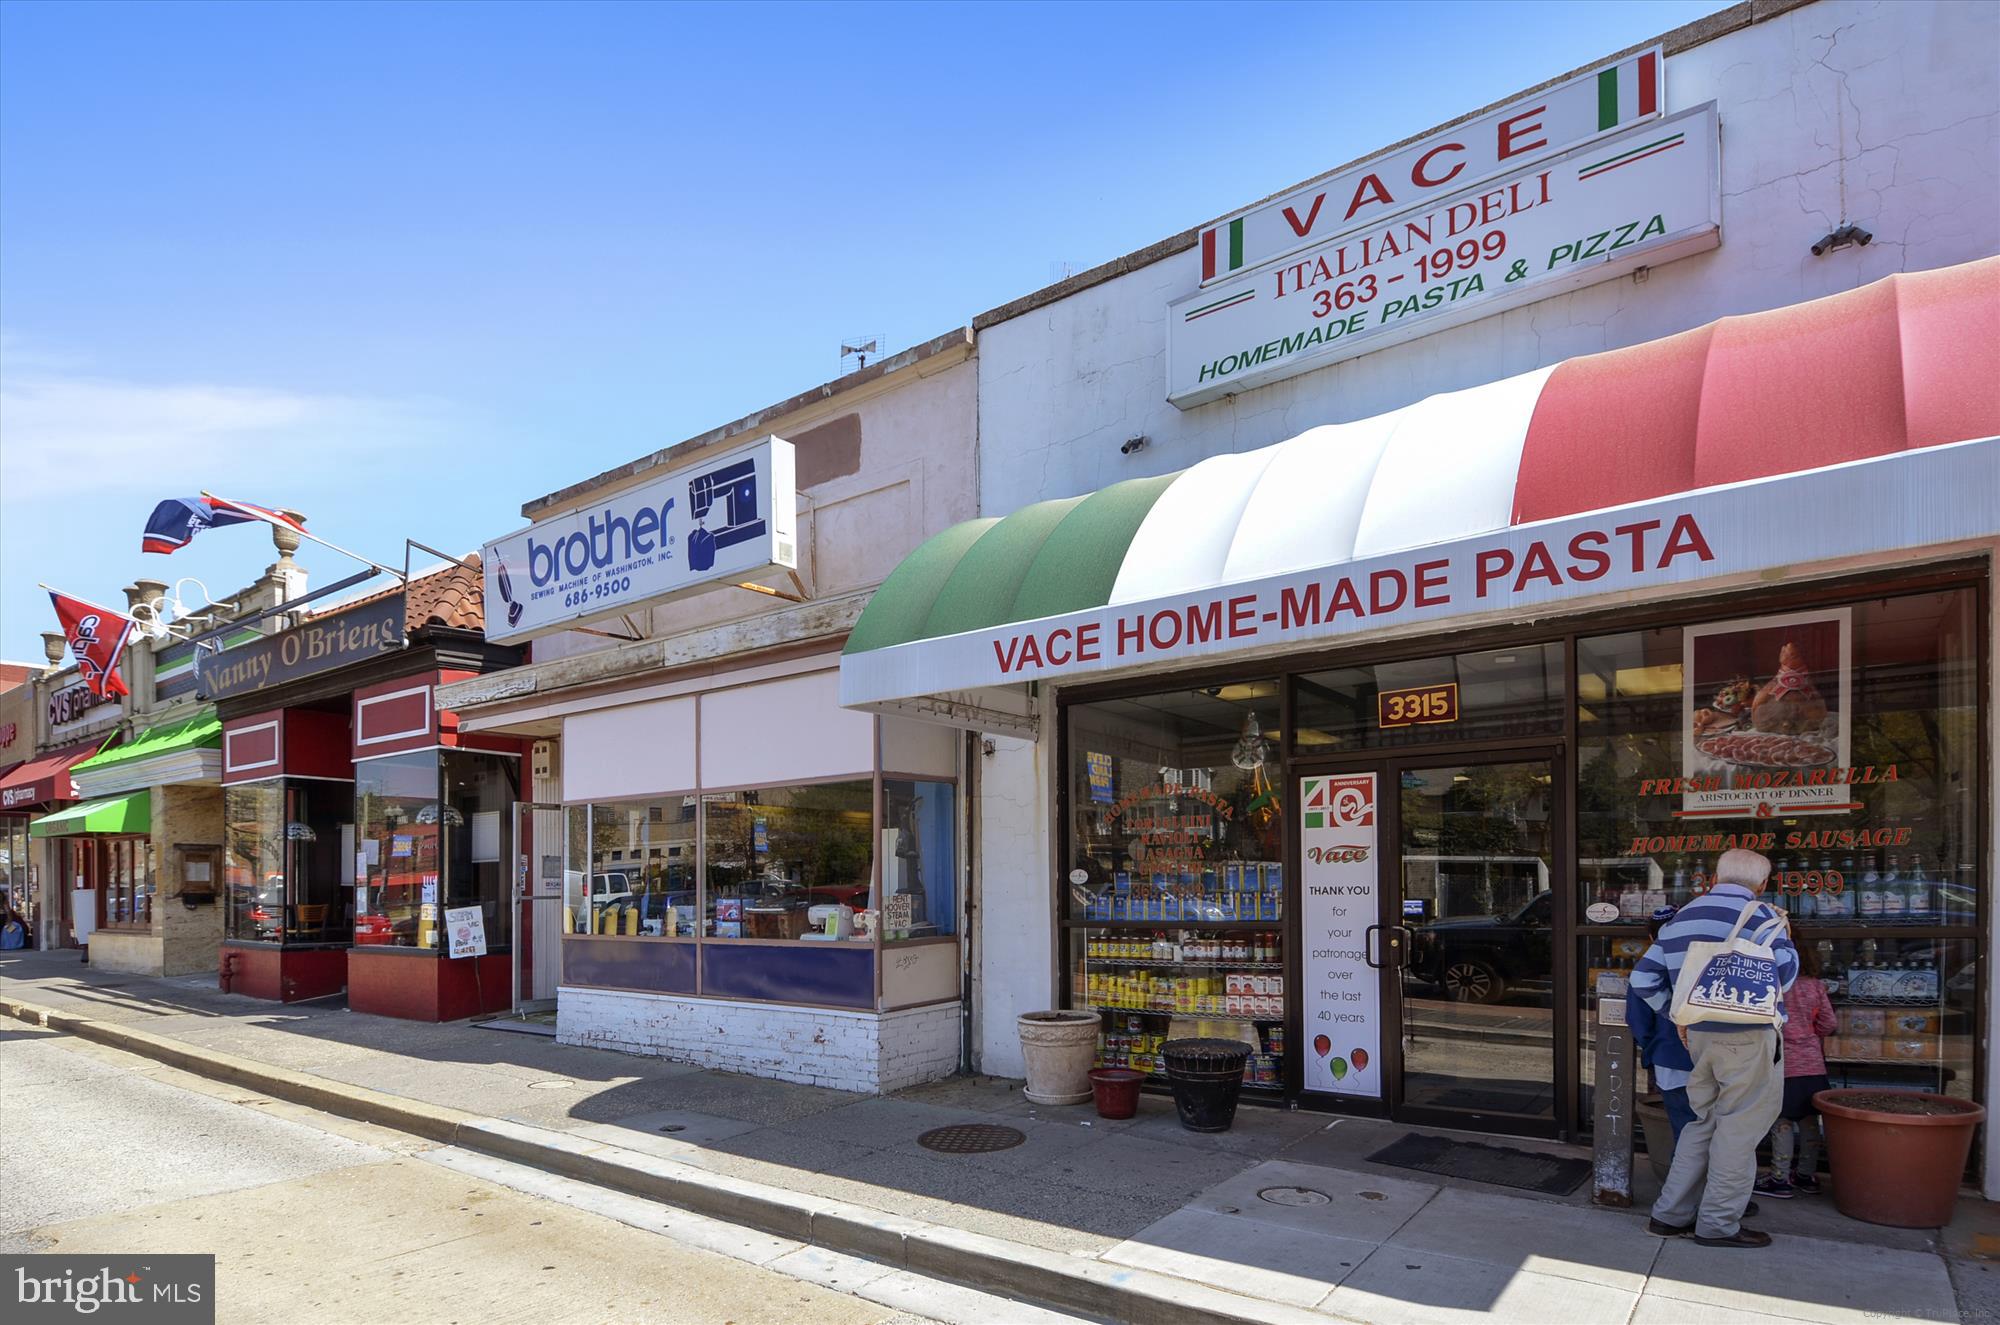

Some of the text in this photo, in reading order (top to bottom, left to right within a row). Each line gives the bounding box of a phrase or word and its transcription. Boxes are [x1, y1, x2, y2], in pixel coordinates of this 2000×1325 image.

[1282, 104, 1548, 238] VACE
[1274, 170, 1553, 299] ITALIAN DELI
[1198, 214, 1666, 383] HOMEMADE PASTA & PIZZA
[527, 496, 675, 588] brother
[531, 550, 673, 601] SEWING MACHINE OF WASHINGTON, INC.
[565, 576, 631, 608] 686-9500
[993, 512, 1715, 674] VACE HOME-MADE PASTA
[203, 651, 272, 696] Nanny
[281, 617, 394, 667] O'Briens
[48, 690, 70, 726] CVS
[1387, 691, 1450, 721] 3315
[1333, 779, 1370, 787] ANNIVERSARY
[1638, 764, 1899, 797] FRESH MOZARELLA
[1698, 787, 1834, 803] ARISTOCRAT OF DINNER
[1756, 801, 1774, 818] &
[1141, 831, 1199, 845] RAVIOLI
[1630, 827, 1912, 855] HOMEMADE SAUSAGE
[1135, 846, 1205, 861] LASAGNA
[1307, 844, 1371, 866] Vace
[1309, 885, 1371, 896] THANK YOU
[884, 902, 911, 912] HOOVER
[887, 911, 910, 920] STEAM
[1332, 906, 1347, 917] for
[1327, 928, 1352, 940] your
[1312, 948, 1367, 961] patronage
[1715, 955, 1772, 971] TEACHING
[1327, 970, 1352, 981] over
[1707, 965, 1775, 983] STRATEGIES
[1320, 989, 1362, 1002] the last
[1317, 1010, 1365, 1023] 40 years
